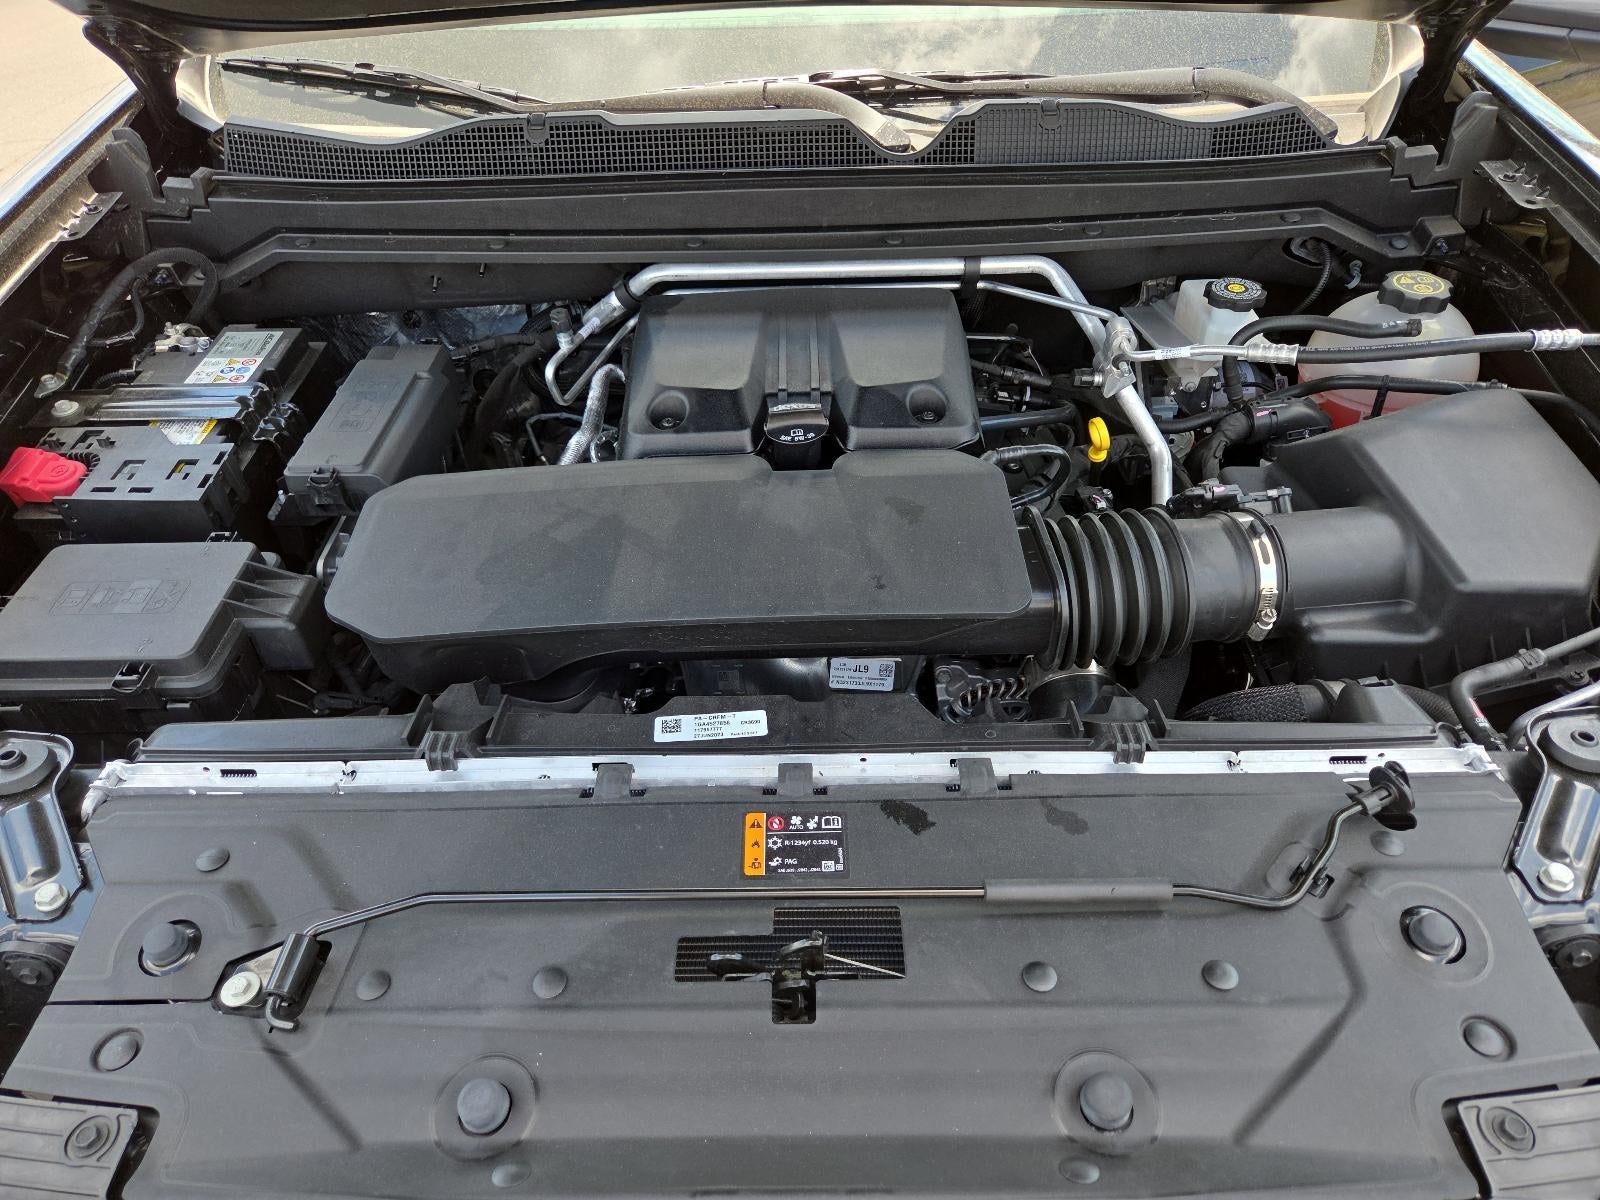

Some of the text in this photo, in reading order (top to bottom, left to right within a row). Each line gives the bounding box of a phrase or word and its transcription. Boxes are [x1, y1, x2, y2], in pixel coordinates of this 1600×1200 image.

[852, 664, 869, 673] JL9
[784, 839, 811, 847] R-1234yf
[830, 838, 838, 846] kg
